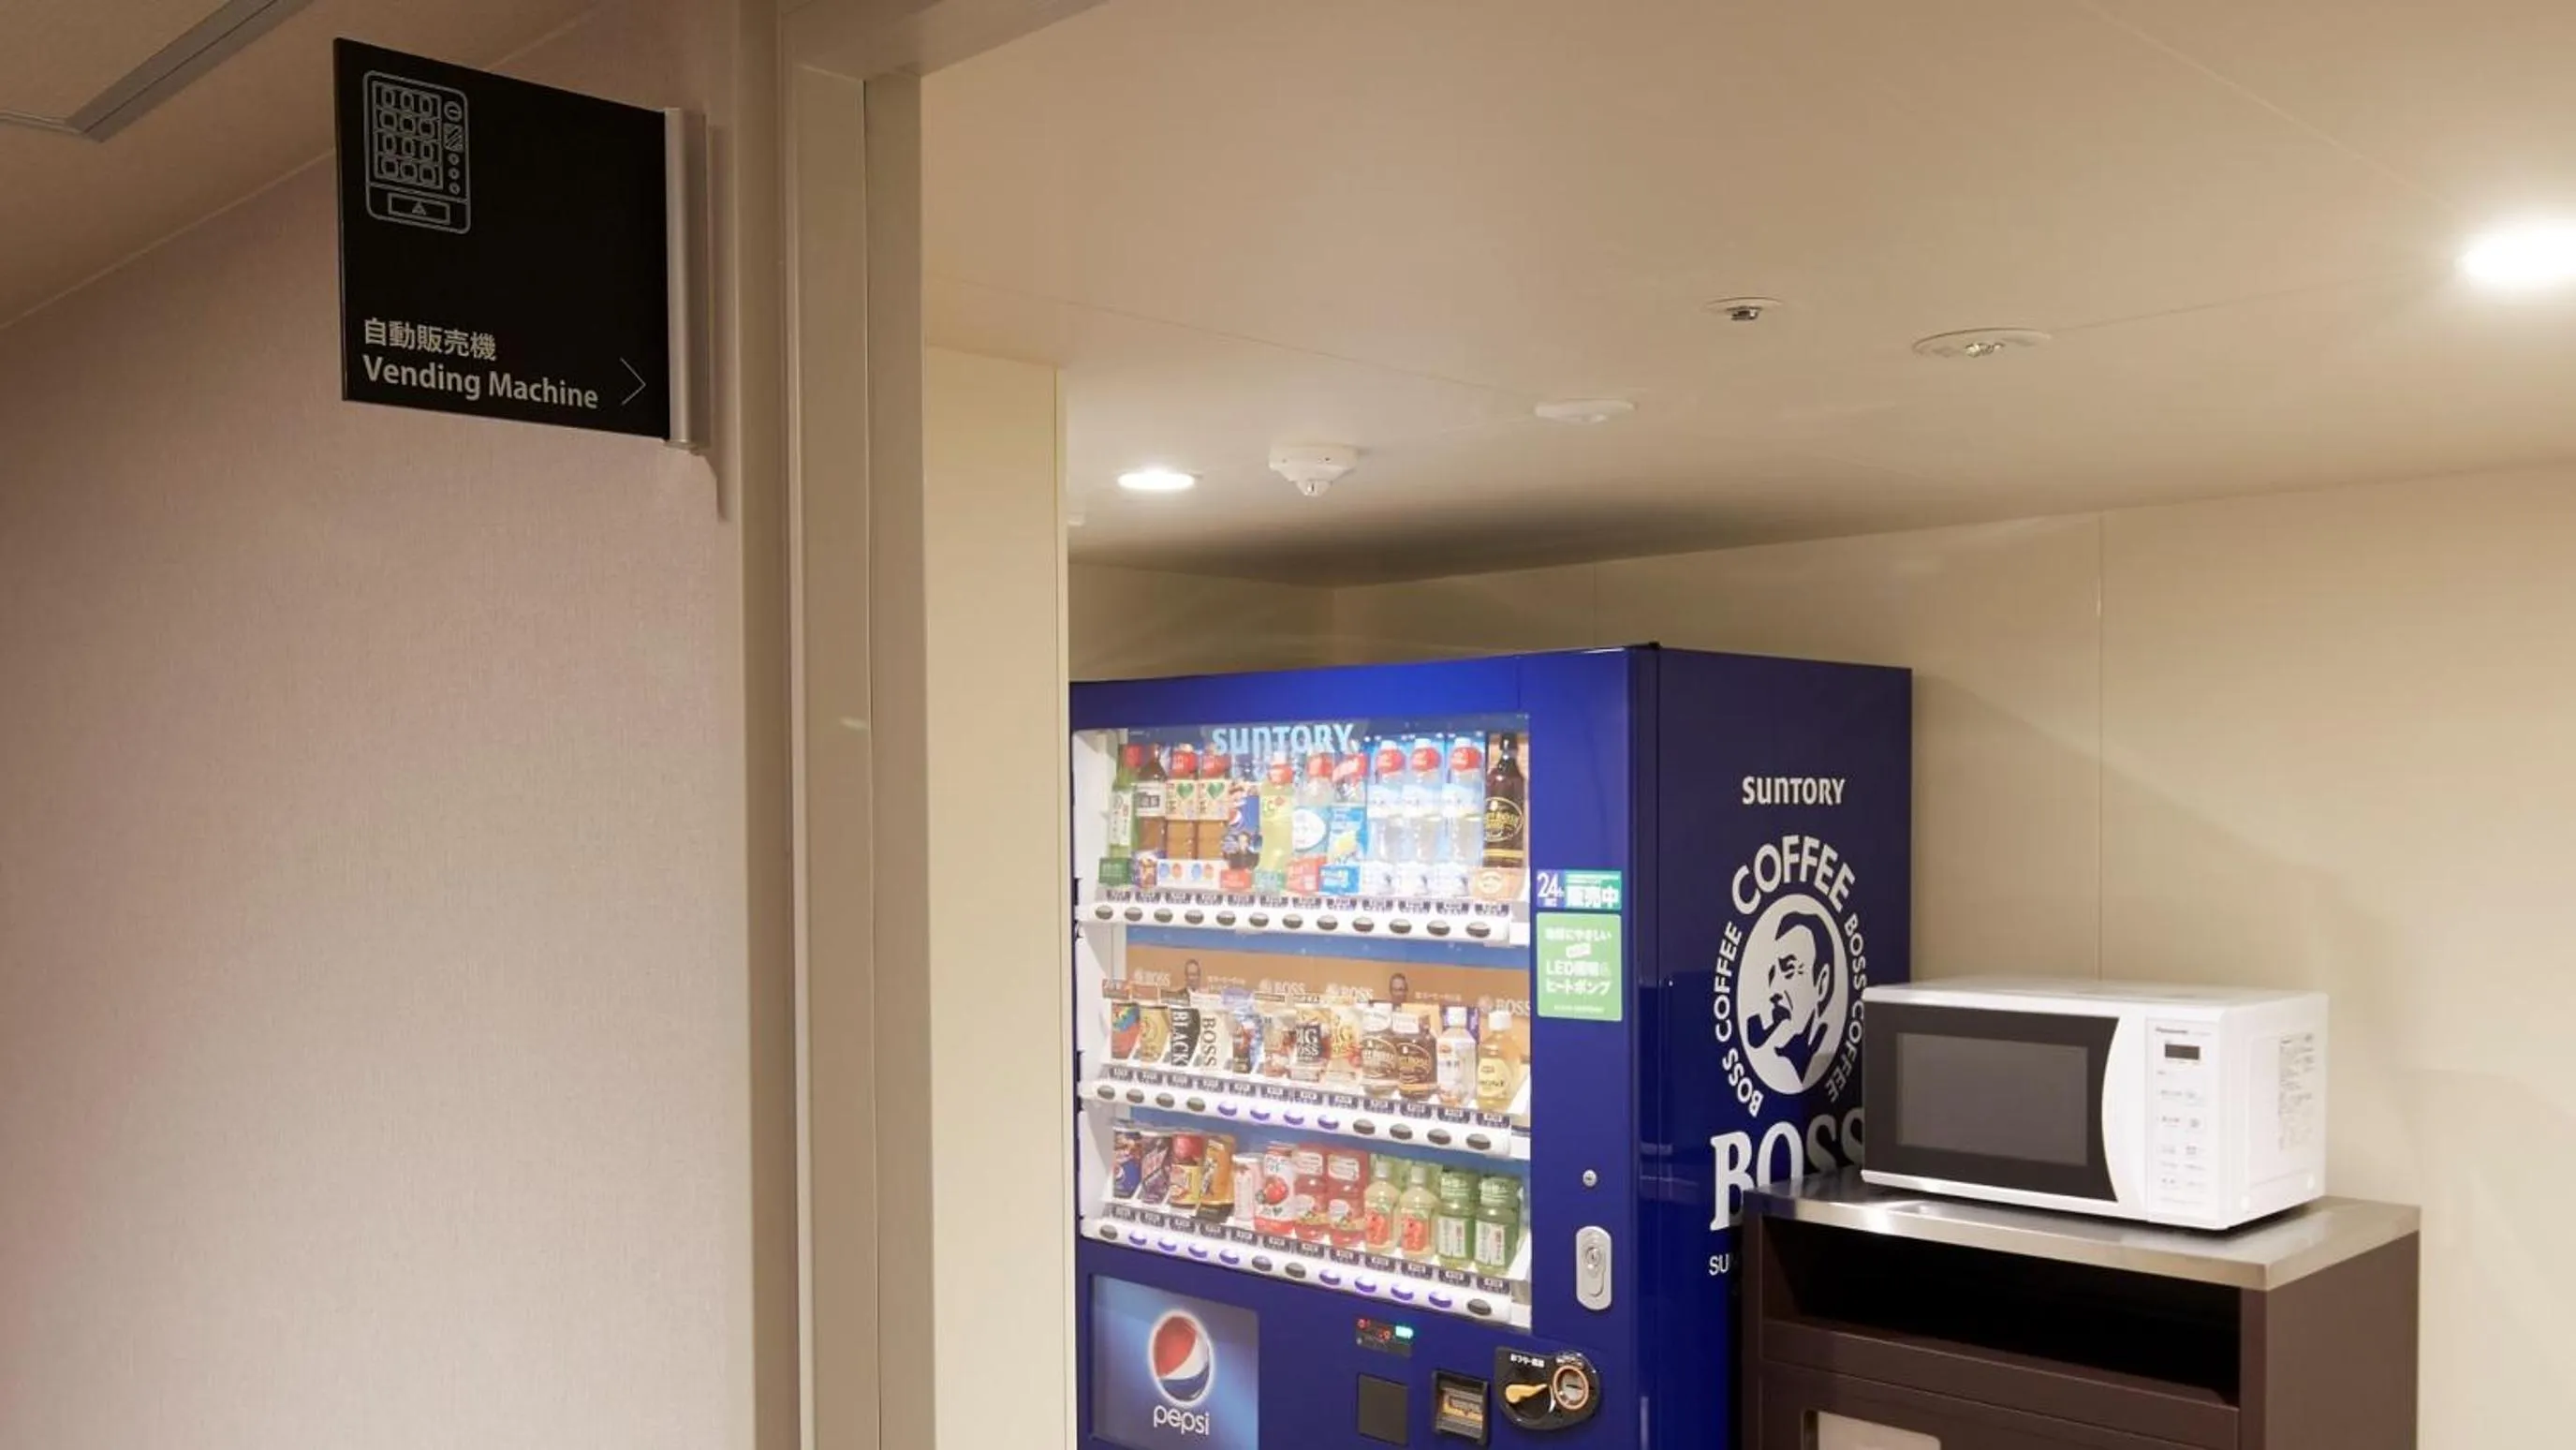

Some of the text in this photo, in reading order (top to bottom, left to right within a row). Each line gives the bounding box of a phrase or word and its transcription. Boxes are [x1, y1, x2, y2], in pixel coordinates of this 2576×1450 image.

[363, 317, 496, 362] 自動販売機
[362, 353, 599, 409] Vending Machine
[1212, 722, 1355, 755] SUNTORY
[1742, 776, 1846, 806] SUNTORY
[1731, 834, 1856, 915] COFFEE
[1713, 921, 1764, 1117] BOSS COFFEE
[1825, 912, 1867, 1102] BOSS COFFEE
[1171, 1006, 1189, 1067] BLACK
[1201, 1015, 1217, 1067] BOSS
[1153, 1405, 1210, 1435] pepsi
